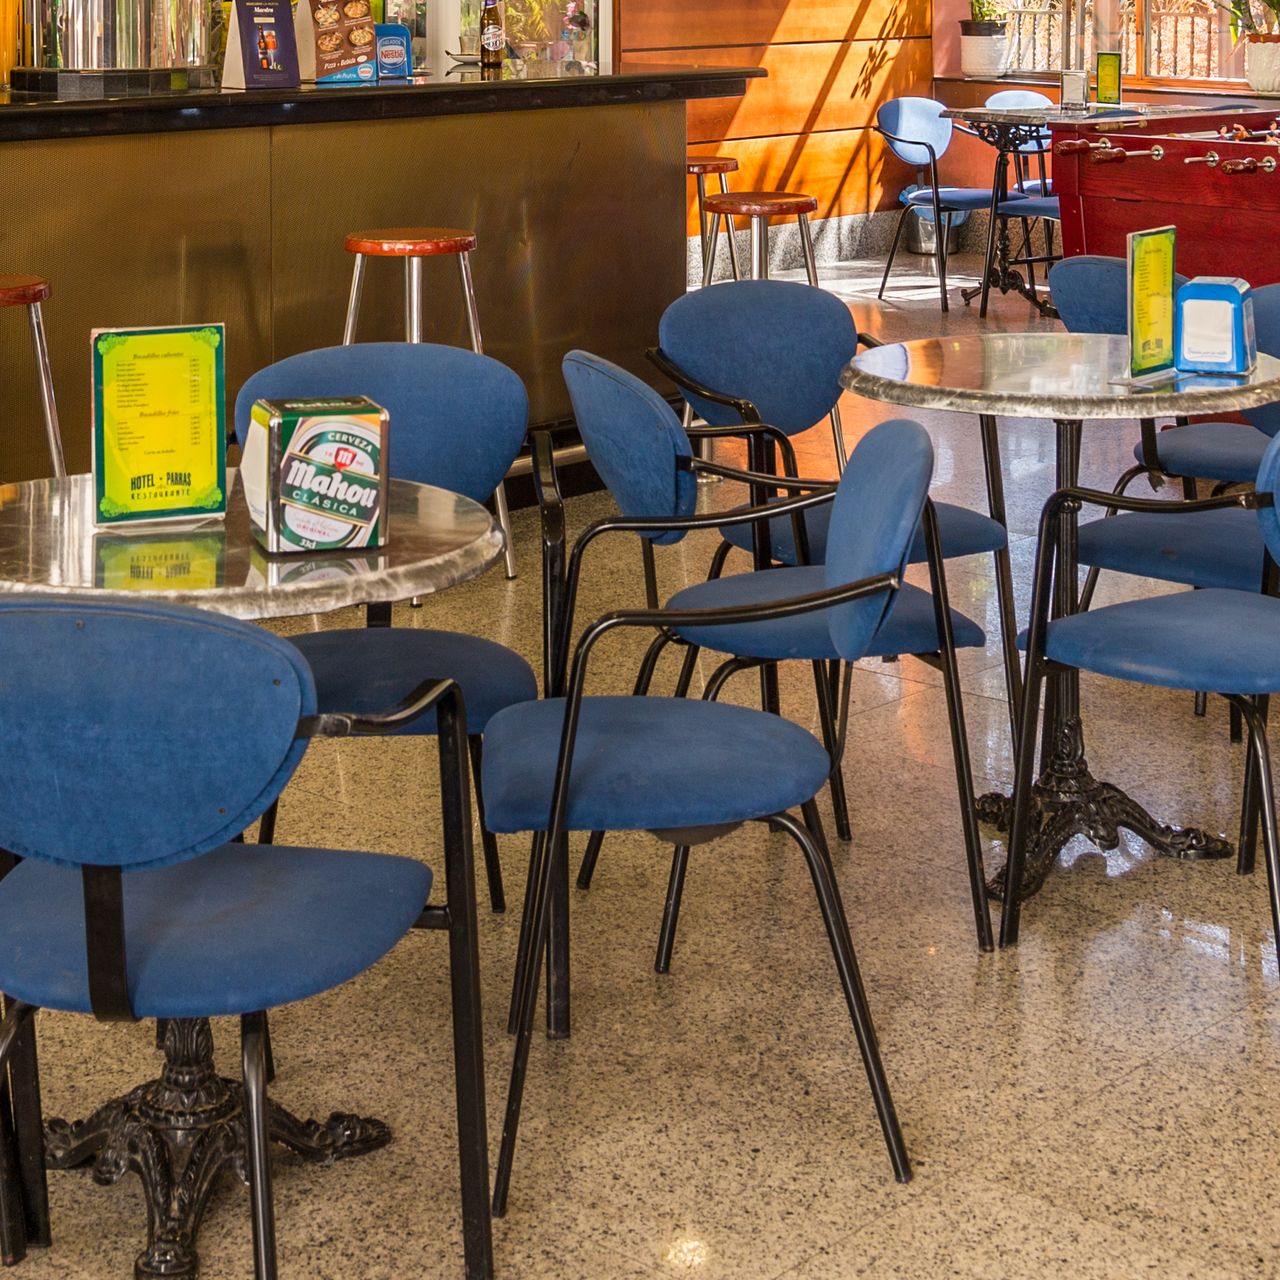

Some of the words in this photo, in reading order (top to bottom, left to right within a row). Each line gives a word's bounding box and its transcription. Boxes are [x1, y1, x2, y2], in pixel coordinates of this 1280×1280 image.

[380, 50, 404, 59] Nestlé
[328, 432, 372, 453] CERVEZA
[130, 474, 155, 491] HOTEL
[166, 472, 192, 486] PARRAS
[286, 460, 377, 508] Mahou
[296, 523, 331, 538] ORIGINAL
